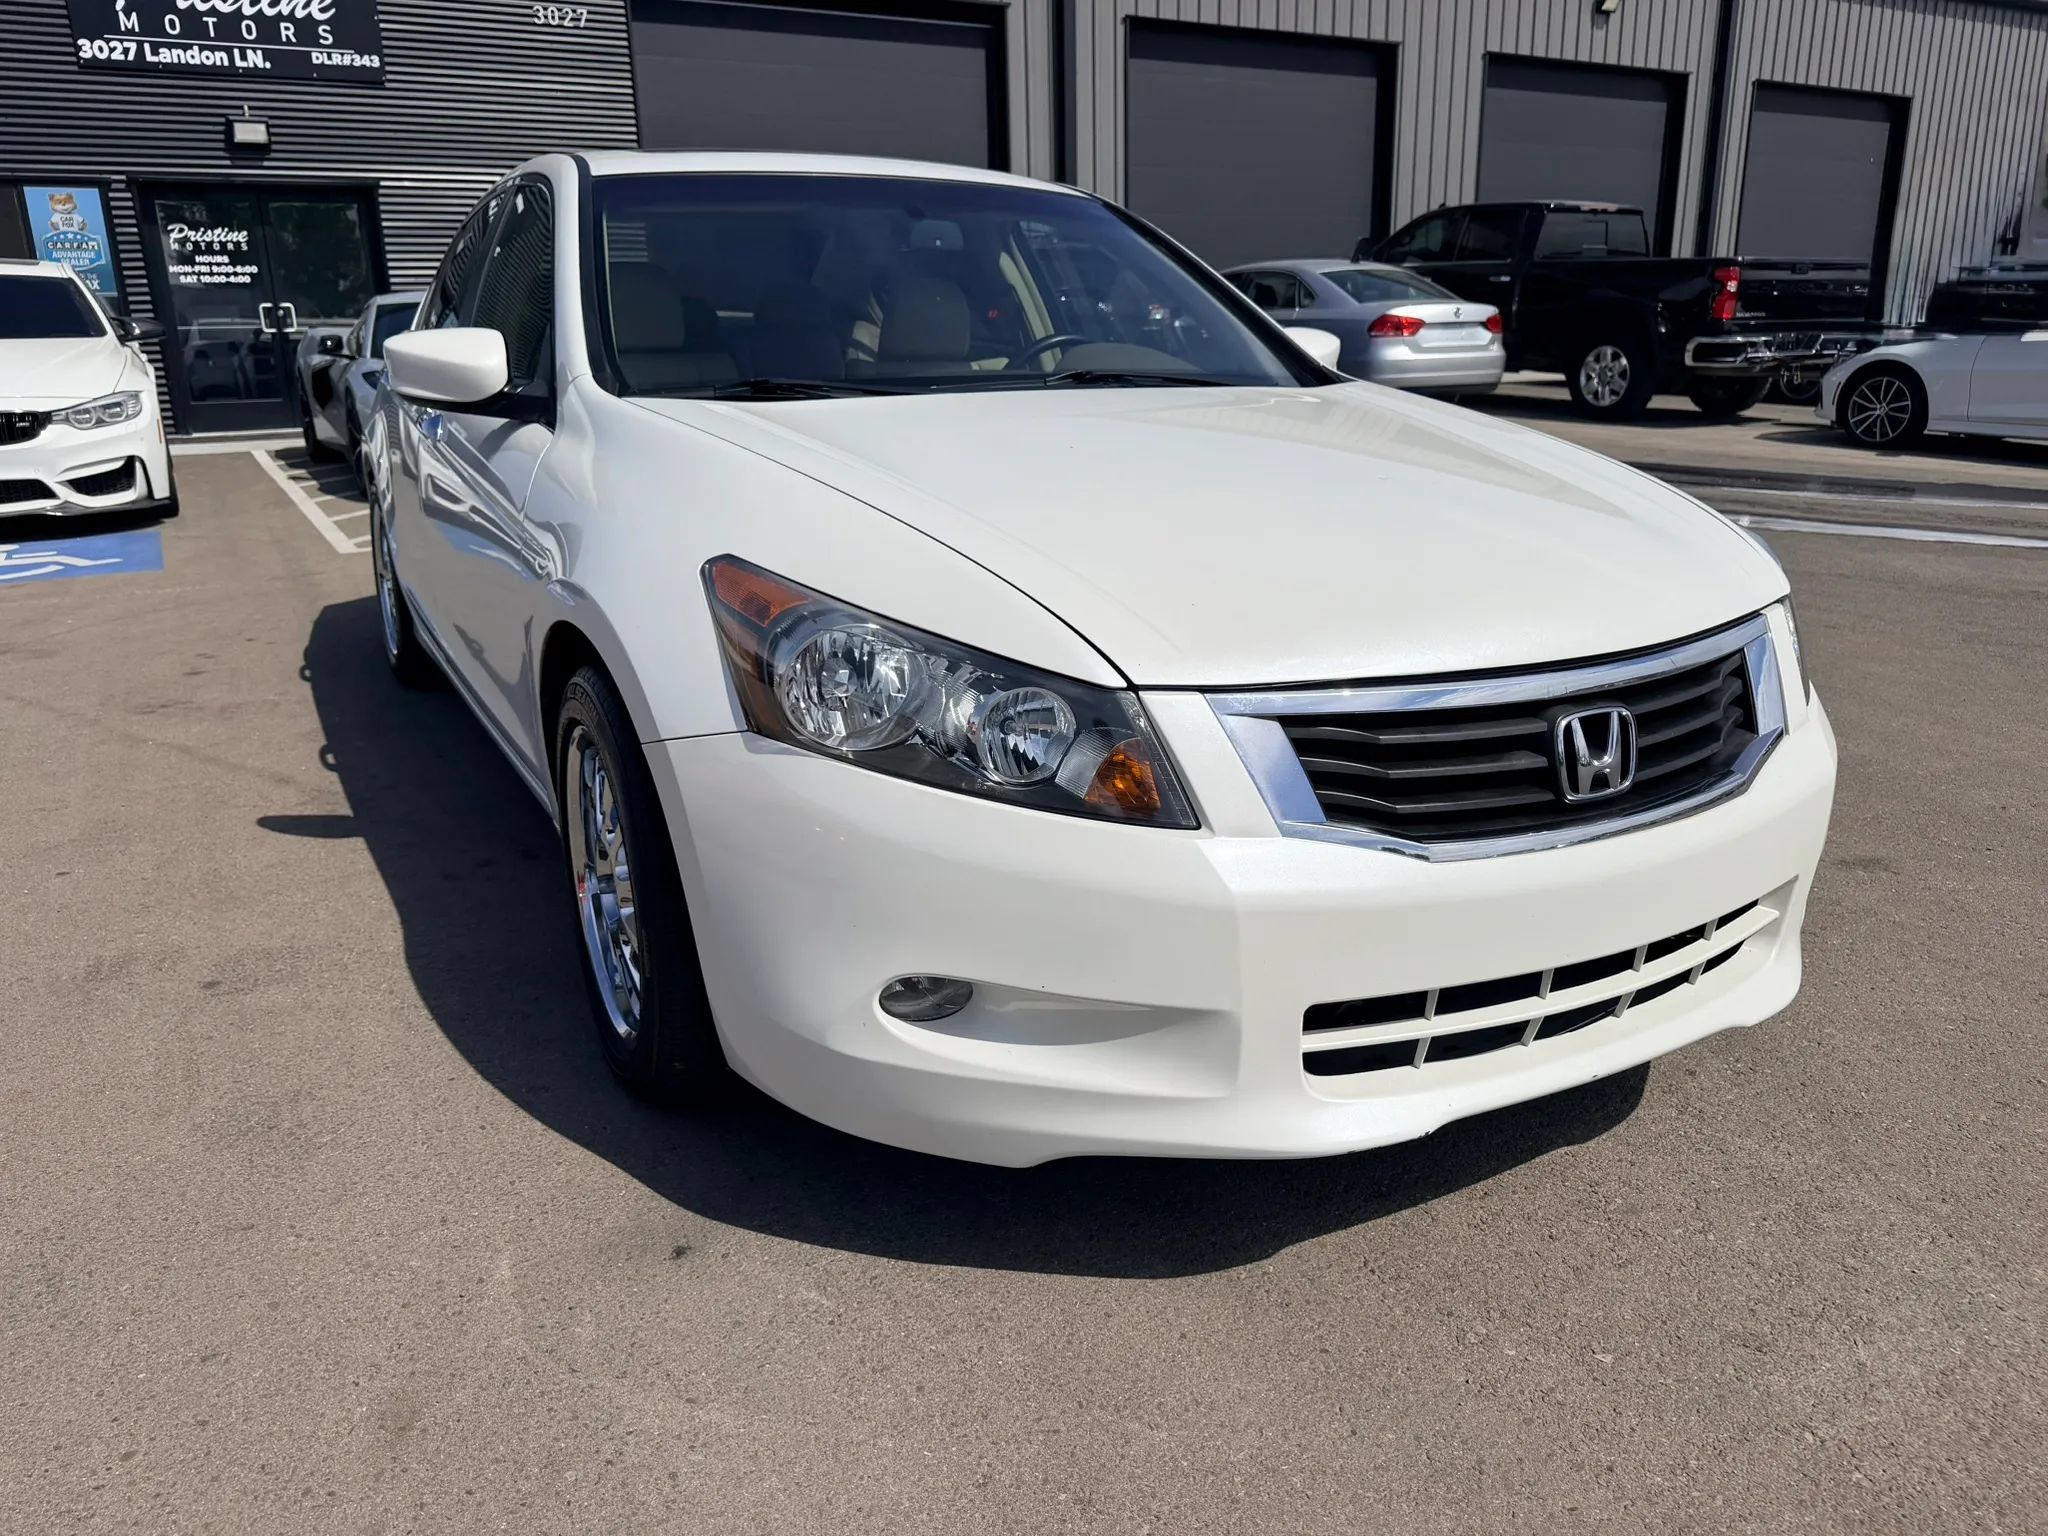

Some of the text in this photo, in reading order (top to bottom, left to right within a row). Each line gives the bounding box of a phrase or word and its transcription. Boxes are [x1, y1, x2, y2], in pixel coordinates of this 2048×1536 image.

[532, 5, 588, 28] 3027
[118, 11, 334, 45] MOTORS
[76, 38, 381, 69] 3027 Landon LN. DLR#343
[167, 223, 249, 243] Pristine
[47, 241, 98, 250] CARFAX
[170, 242, 248, 251] MOTORS
[52, 251, 96, 259] ADVANTAGE
[195, 255, 230, 263] HOURS
[168, 265, 259, 273] MON-FRI 9:00-6:00
[179, 275, 252, 283] SAT 10:00-4:00
